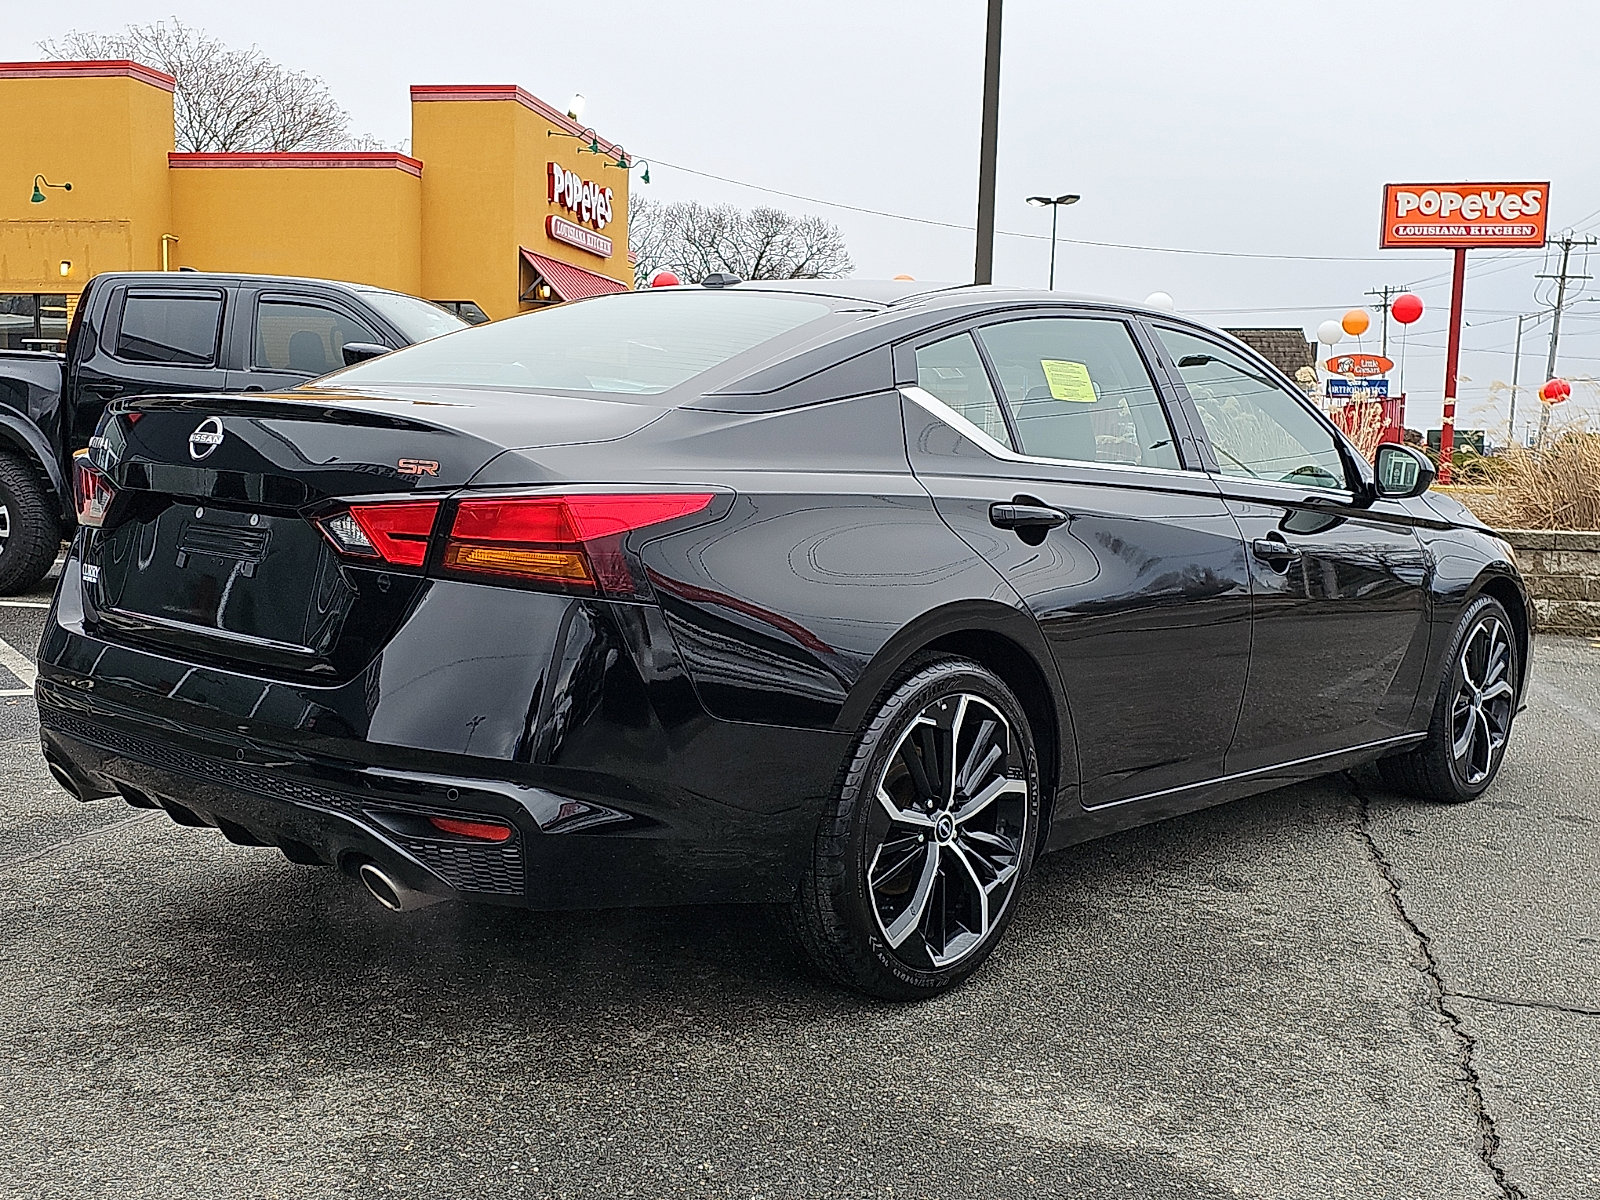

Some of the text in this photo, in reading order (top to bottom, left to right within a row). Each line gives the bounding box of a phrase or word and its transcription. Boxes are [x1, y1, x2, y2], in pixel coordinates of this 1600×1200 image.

[1398, 226, 1533, 236] LOUISIANA KITCHEN
[397, 458, 438, 477] SR
